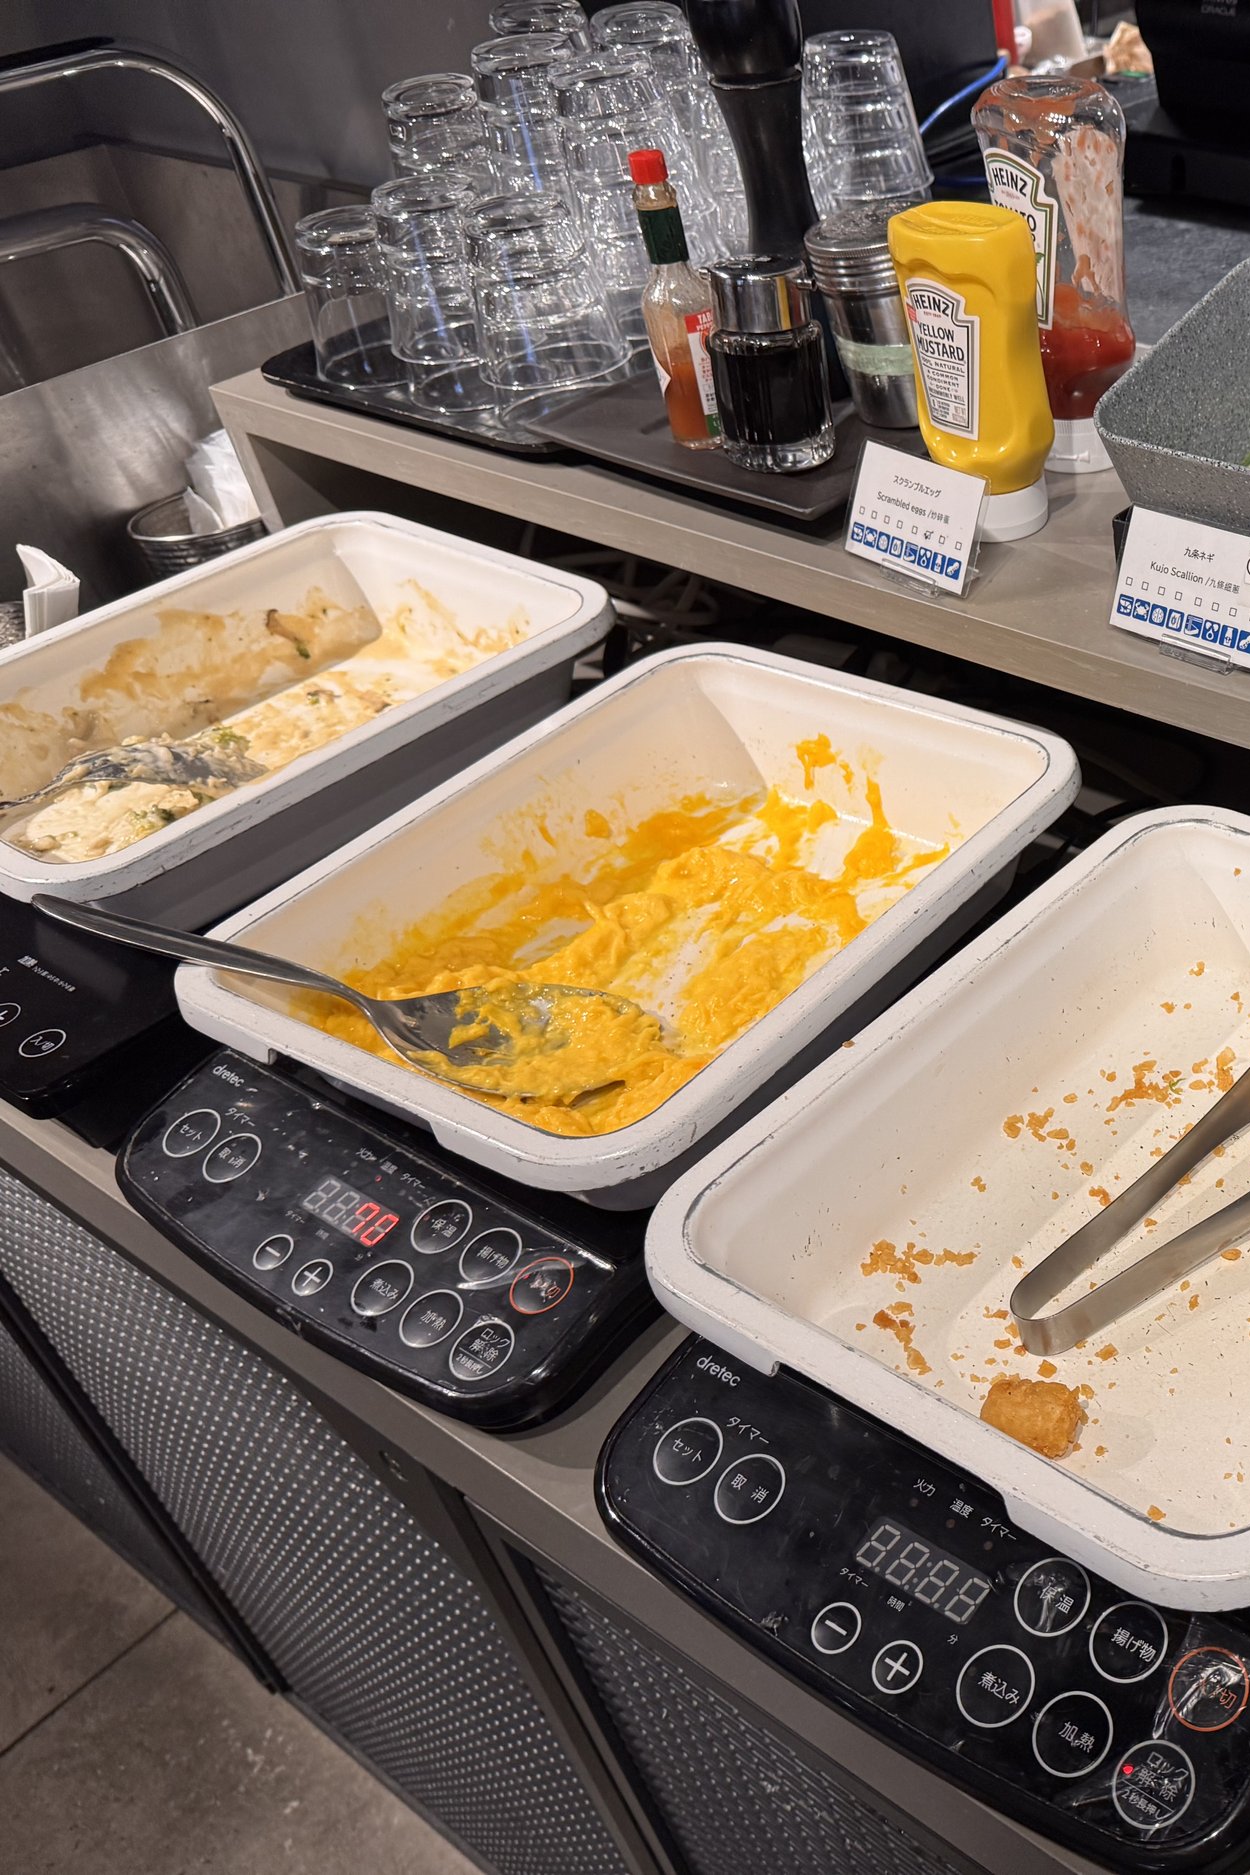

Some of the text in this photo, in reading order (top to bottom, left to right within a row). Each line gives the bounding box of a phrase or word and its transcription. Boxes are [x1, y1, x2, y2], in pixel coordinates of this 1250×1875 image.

[992, 167, 1028, 198] HEINZ
[913, 294, 950, 317] HEINZ
[918, 321, 955, 343] YELLOW
[917, 334, 965, 361] MUSTARD
[935, 361, 966, 374] NATURAL
[893, 475, 942, 499] スクランブルエッグ
[877, 491, 910, 511] Scrambled
[911, 505, 926, 518] eggs
[1183, 547, 1216, 563] 九条ネギ
[1150, 561, 1169, 575] Kujo
[1170, 567, 1204, 585] Scallion
[212, 1064, 244, 1087] dretec
[225, 1107, 256, 1127] タイマー
[180, 1123, 203, 1141] セット
[400, 1173, 426, 1189] タイマー
[476, 1246, 510, 1269] 揚げ物
[371, 1278, 401, 1301] 煮込み
[480, 1327, 511, 1348] ロック
[696, 1355, 742, 1387] dretec
[726, 1416, 770, 1445] タイマー
[671, 1438, 703, 1463] セット
[730, 1473, 770, 1503] 取消
[913, 1478, 1018, 1541] 火力 温度 タイマー
[839, 1566, 870, 1588] タイマー
[1039, 1584, 1074, 1614] 保温
[946, 1634, 960, 1645] 分
[1111, 1627, 1157, 1662] 揚げ物
[977, 1671, 1020, 1705] 煮込み
[1057, 1721, 1096, 1753] 加熱
[1146, 1751, 1189, 1781] ロック
[1135, 1764, 1179, 1803] 解除
[1121, 1789, 1174, 1820] 2秒長押し
